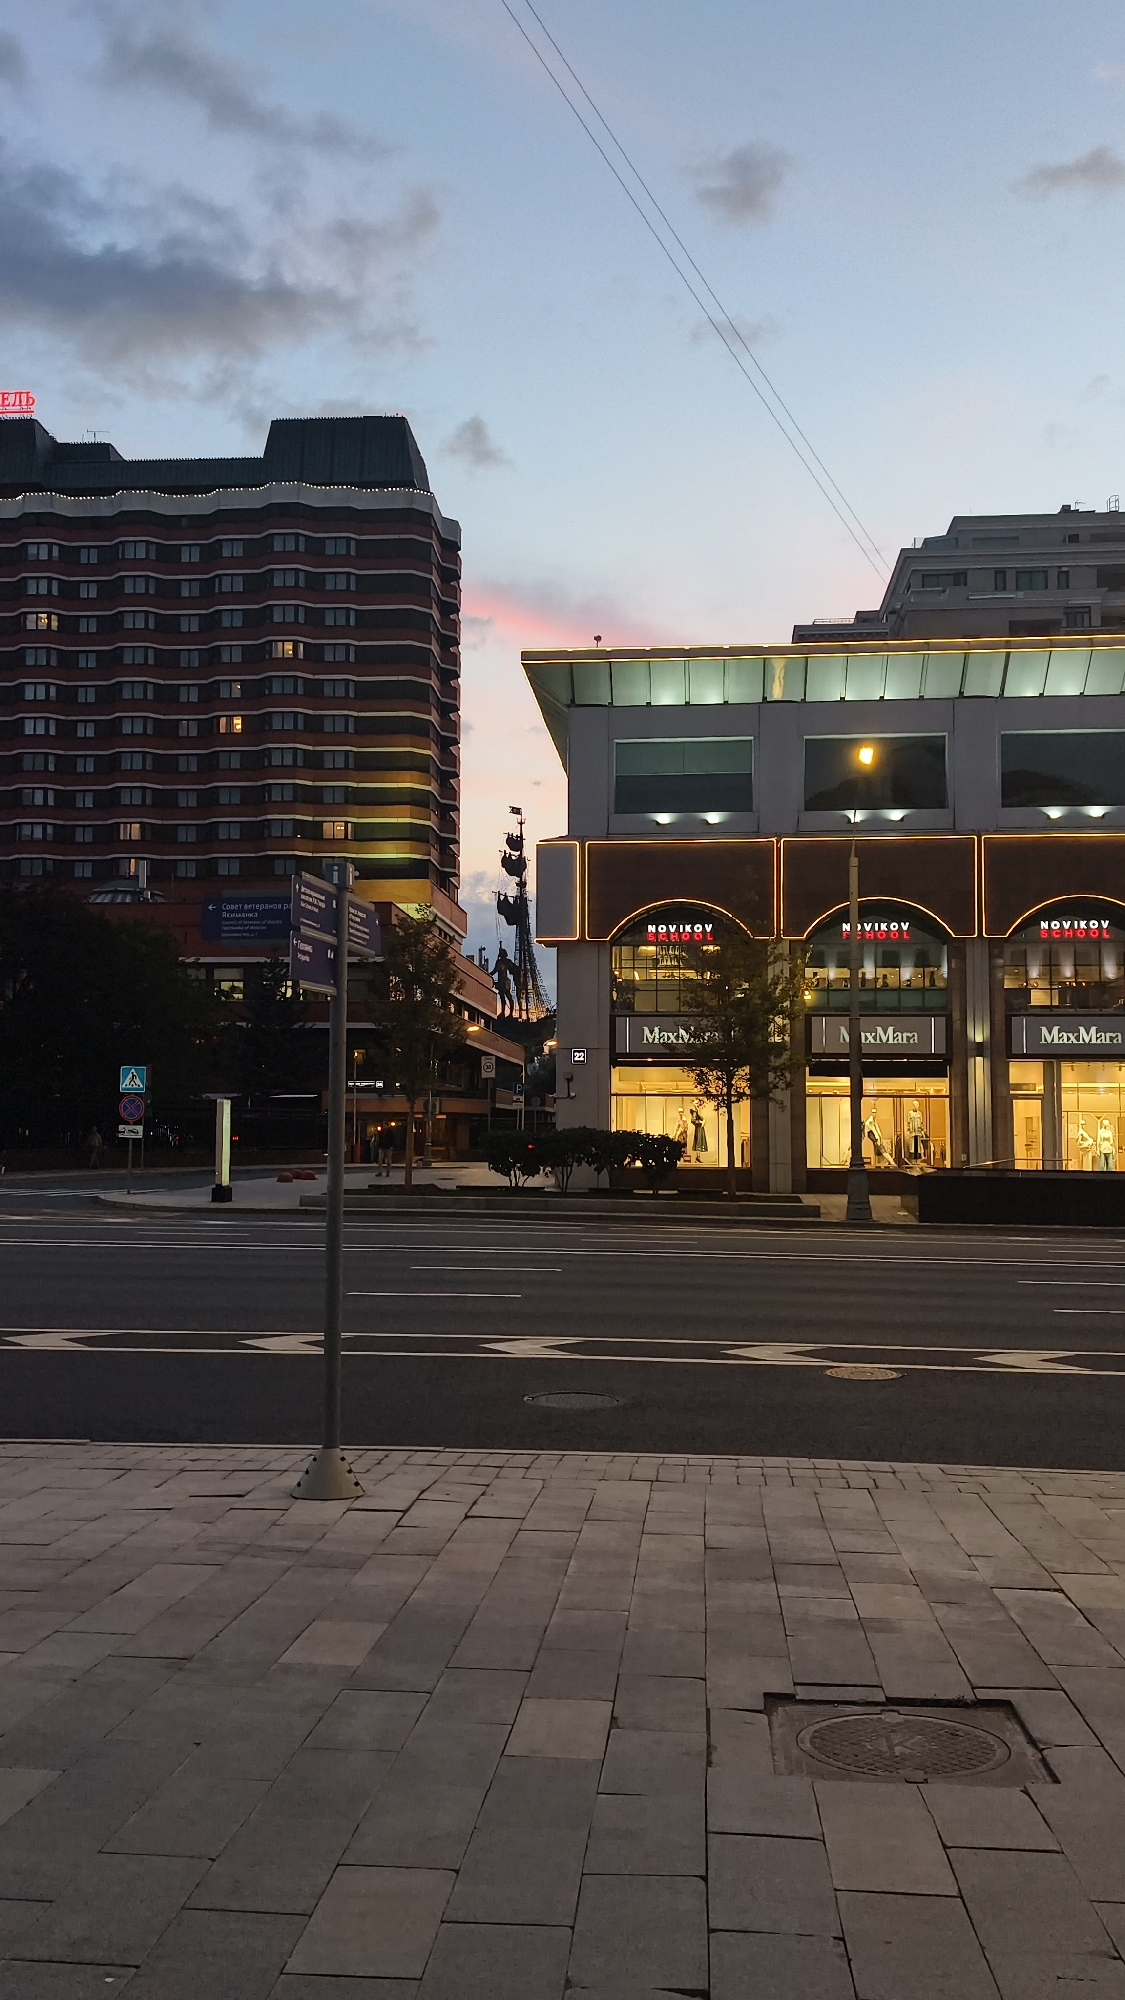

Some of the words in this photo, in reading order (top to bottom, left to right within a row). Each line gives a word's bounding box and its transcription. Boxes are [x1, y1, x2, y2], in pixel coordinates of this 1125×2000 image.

[221, 902, 243, 911] Совет
[243, 903, 282, 911] ветеранов
[647, 923, 713, 933] NOVIKOV
[1040, 920, 1110, 930] NOVIKOV
[647, 932, 714, 942] SCHOOL
[1040, 929, 1110, 939] SCHOOL
[1039, 1026, 1123, 1044] MaxMara
[573, 1052, 585, 1061] 22
